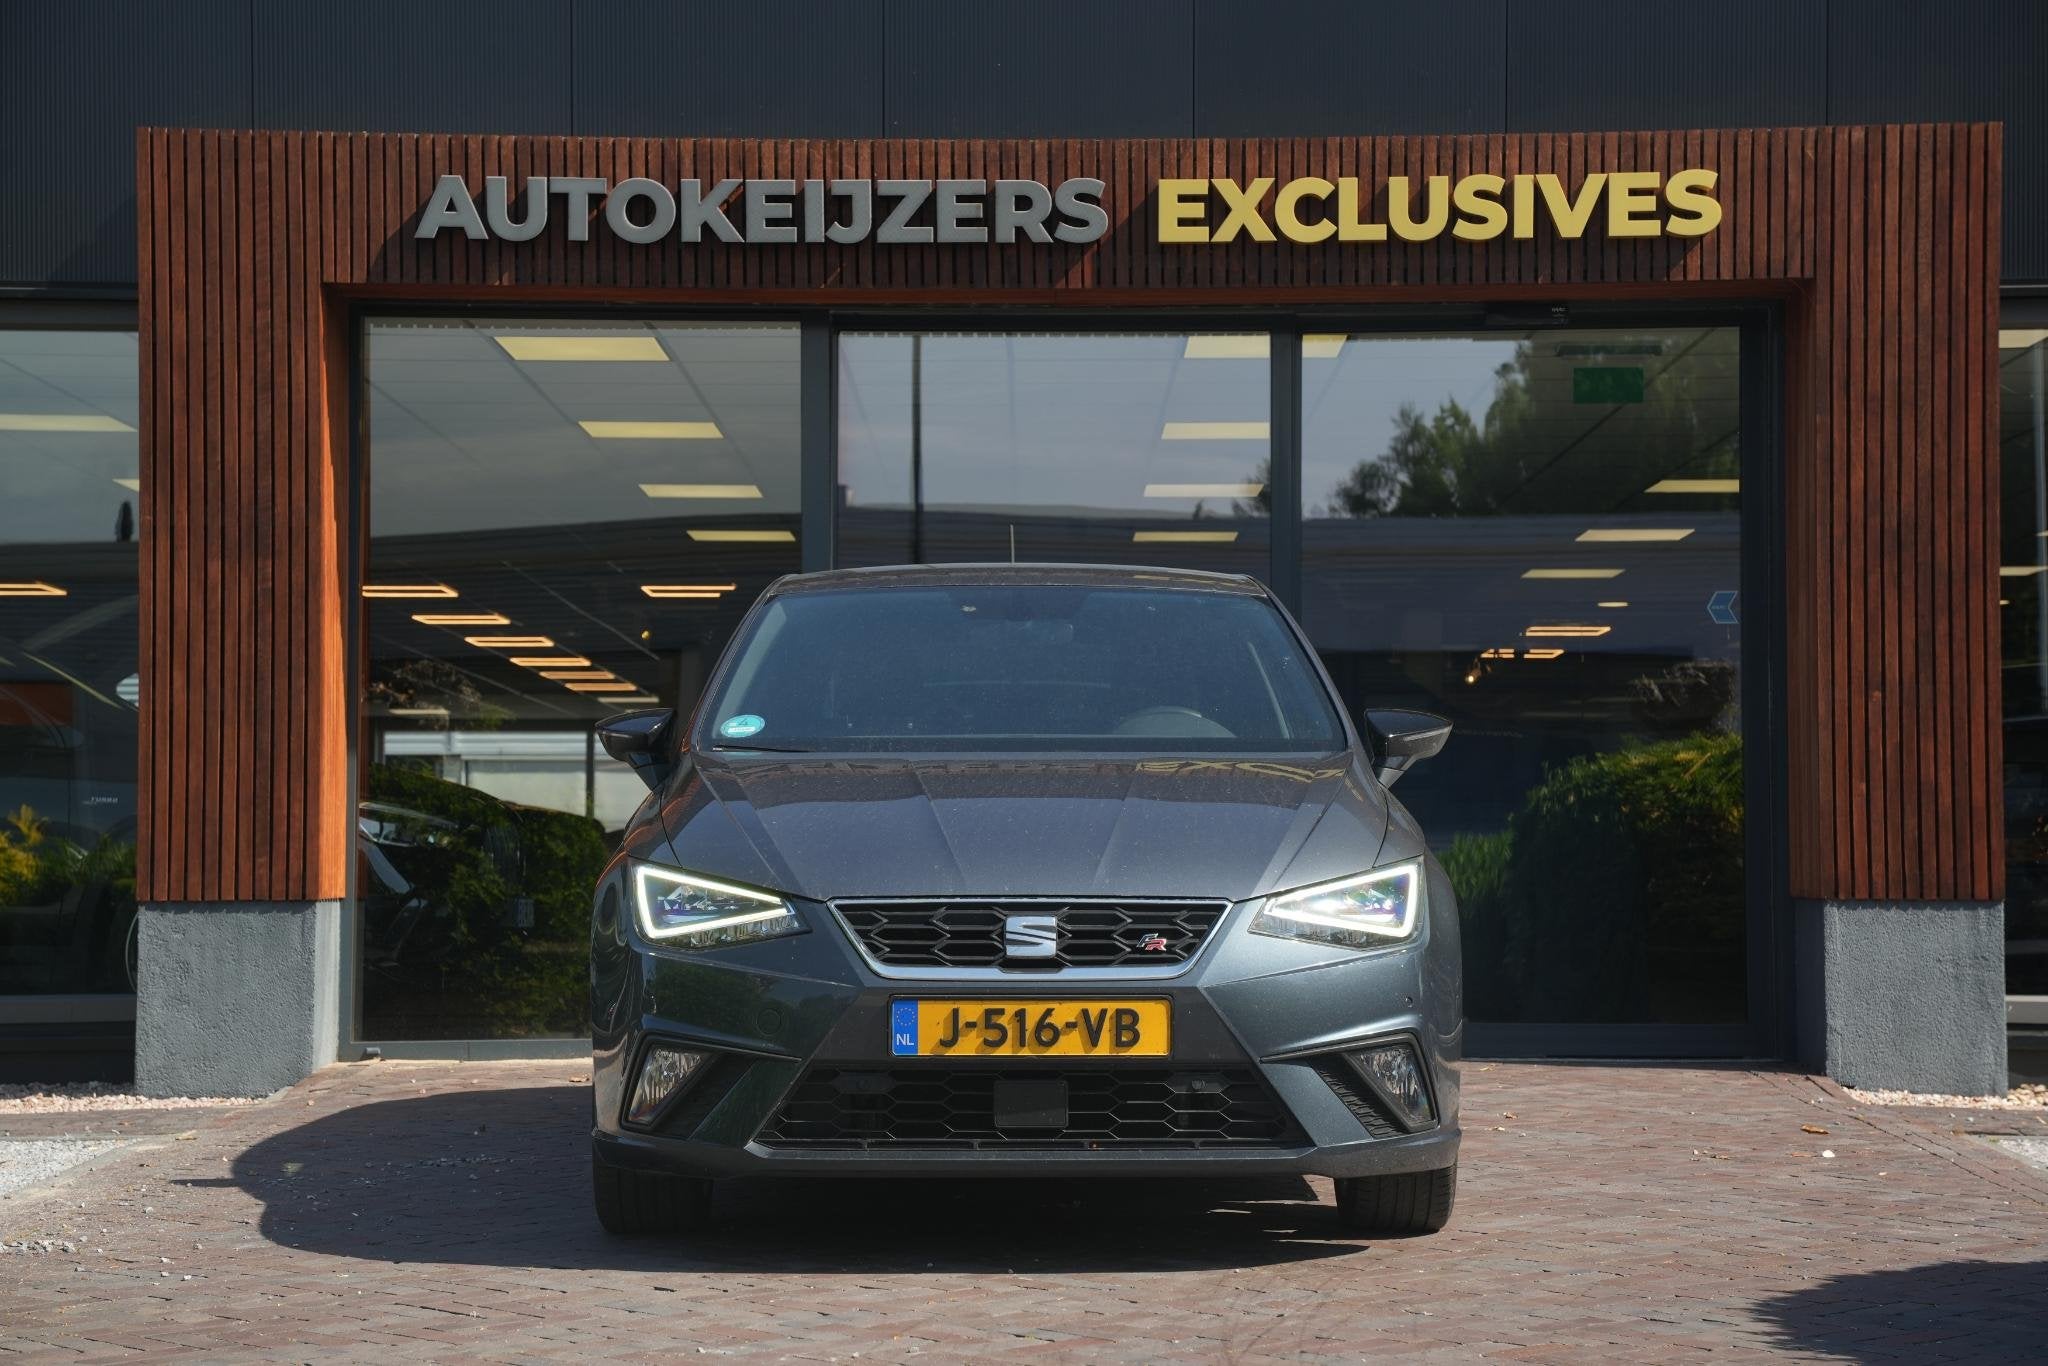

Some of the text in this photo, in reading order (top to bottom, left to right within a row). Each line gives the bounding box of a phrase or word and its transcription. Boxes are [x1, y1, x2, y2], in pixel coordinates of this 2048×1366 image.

[414, 169, 1723, 244] AUTOKEIJZERS EXCLUSIVES
[1136, 932, 1167, 951] FR
[896, 1034, 914, 1046] NL
[939, 1007, 1141, 1048] J-516-VB
